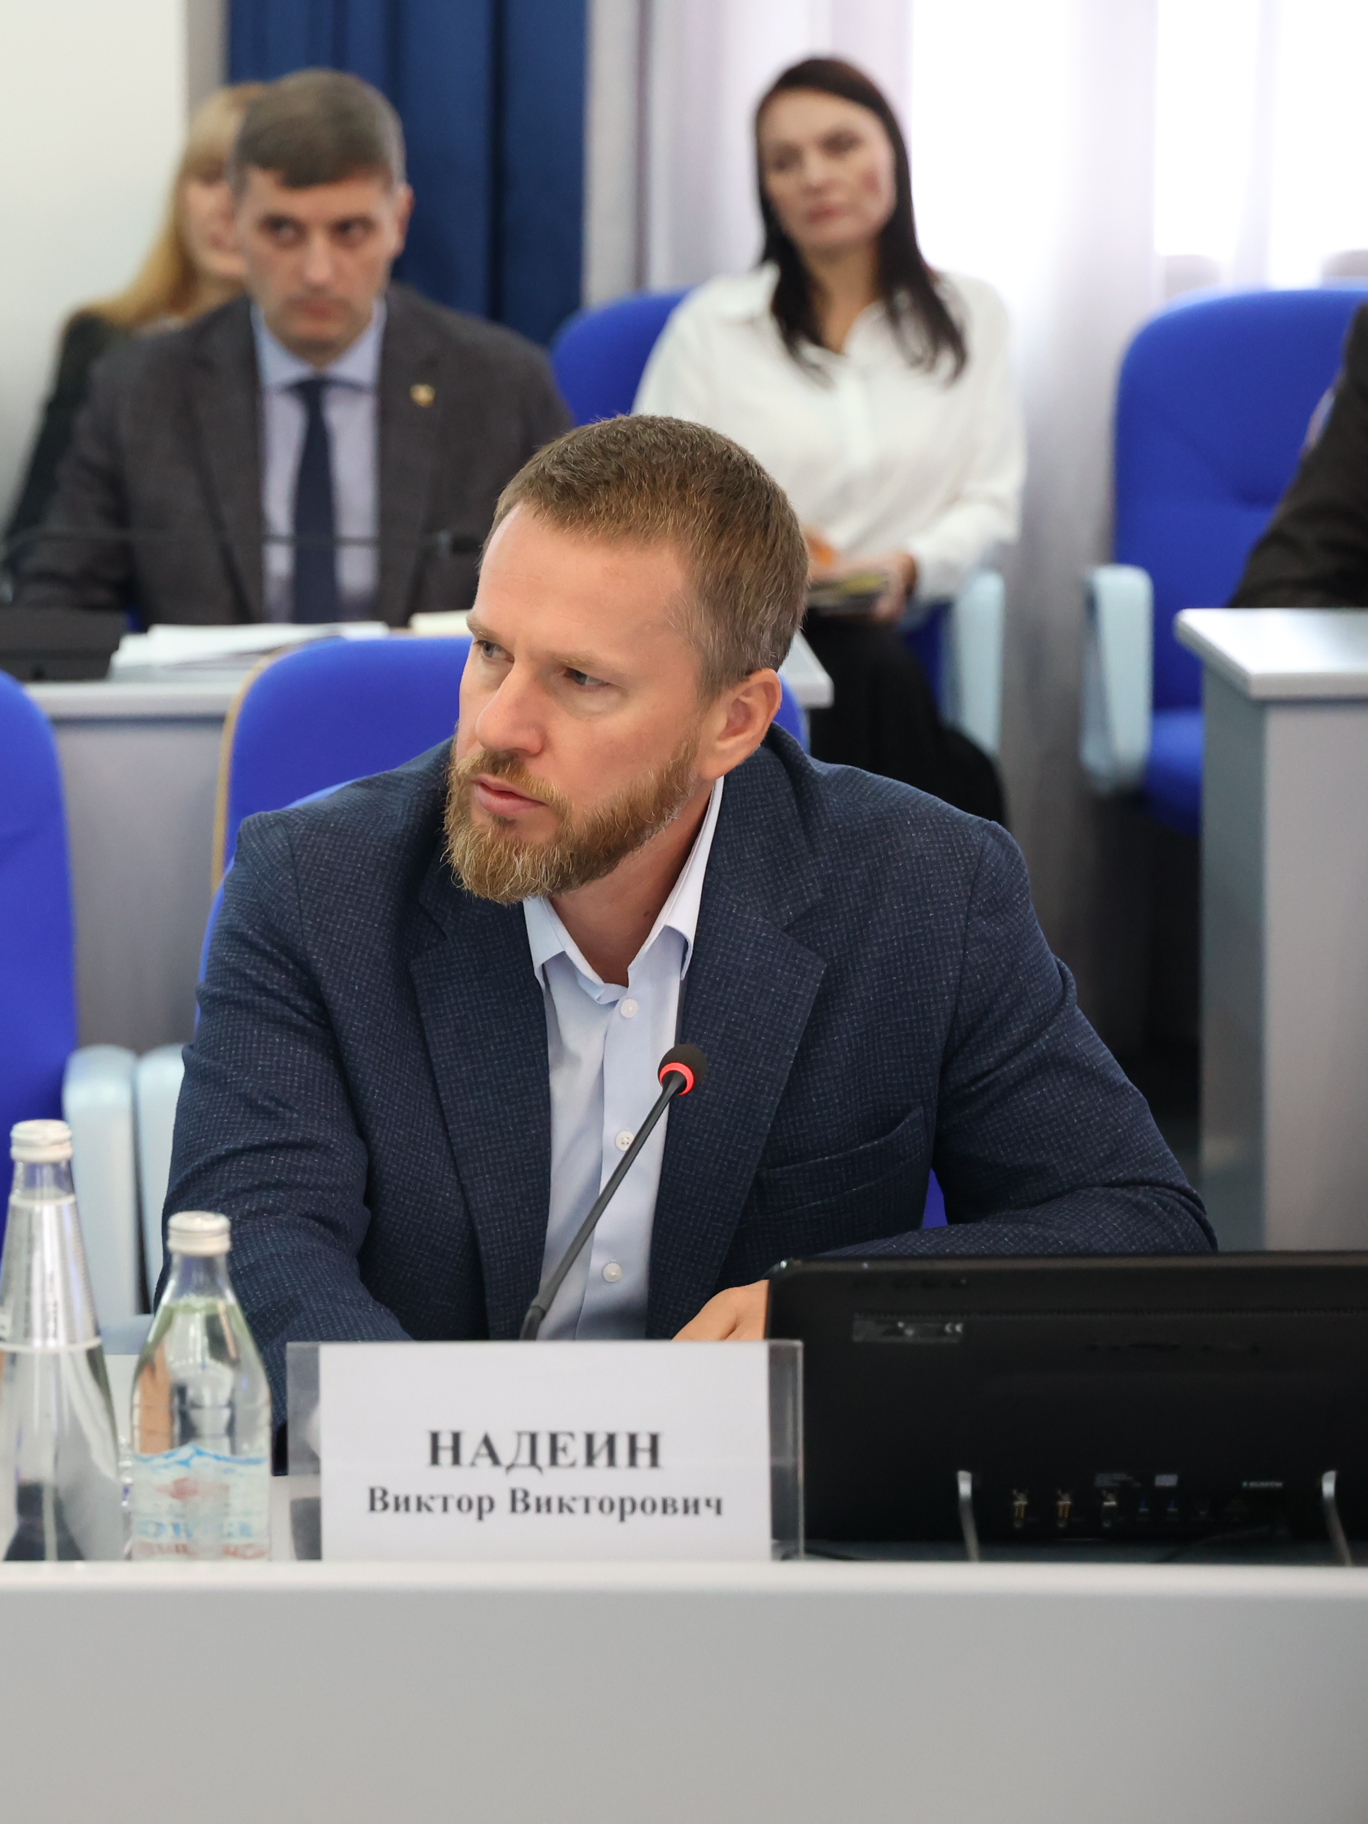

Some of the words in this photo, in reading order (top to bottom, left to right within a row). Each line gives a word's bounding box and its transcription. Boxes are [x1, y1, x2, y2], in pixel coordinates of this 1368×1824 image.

[429, 1430, 660, 1474] НАДЕИН
[368, 1486, 496, 1521] Виктор
[509, 1487, 722, 1523] Викторович
